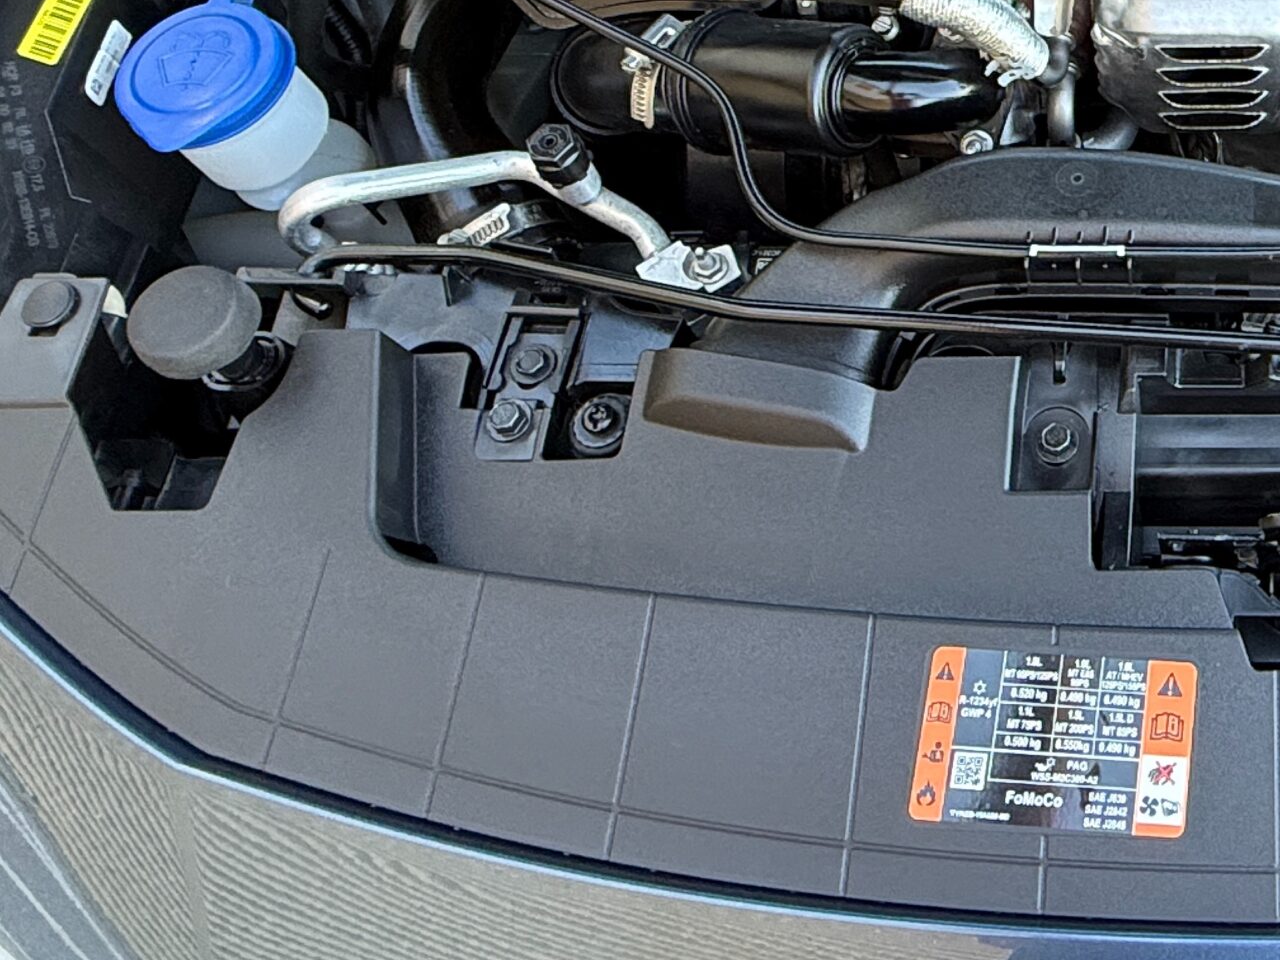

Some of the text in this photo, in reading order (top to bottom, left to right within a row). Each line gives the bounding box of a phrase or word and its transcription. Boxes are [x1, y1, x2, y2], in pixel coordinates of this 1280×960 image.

[959, 694, 999, 709] R-1234yf
[1035, 689, 1048, 702] kg
[961, 707, 985, 718] GWP
[1006, 718, 1019, 729] MT
[1029, 737, 1042, 750] kg
[1123, 743, 1136, 757] kg
[1066, 760, 1088, 771] PAG
[1005, 790, 1063, 808] FoMoCo
[1089, 792, 1105, 803] SAE
[1084, 804, 1101, 816] SAE
[1083, 817, 1100, 829] SAE
